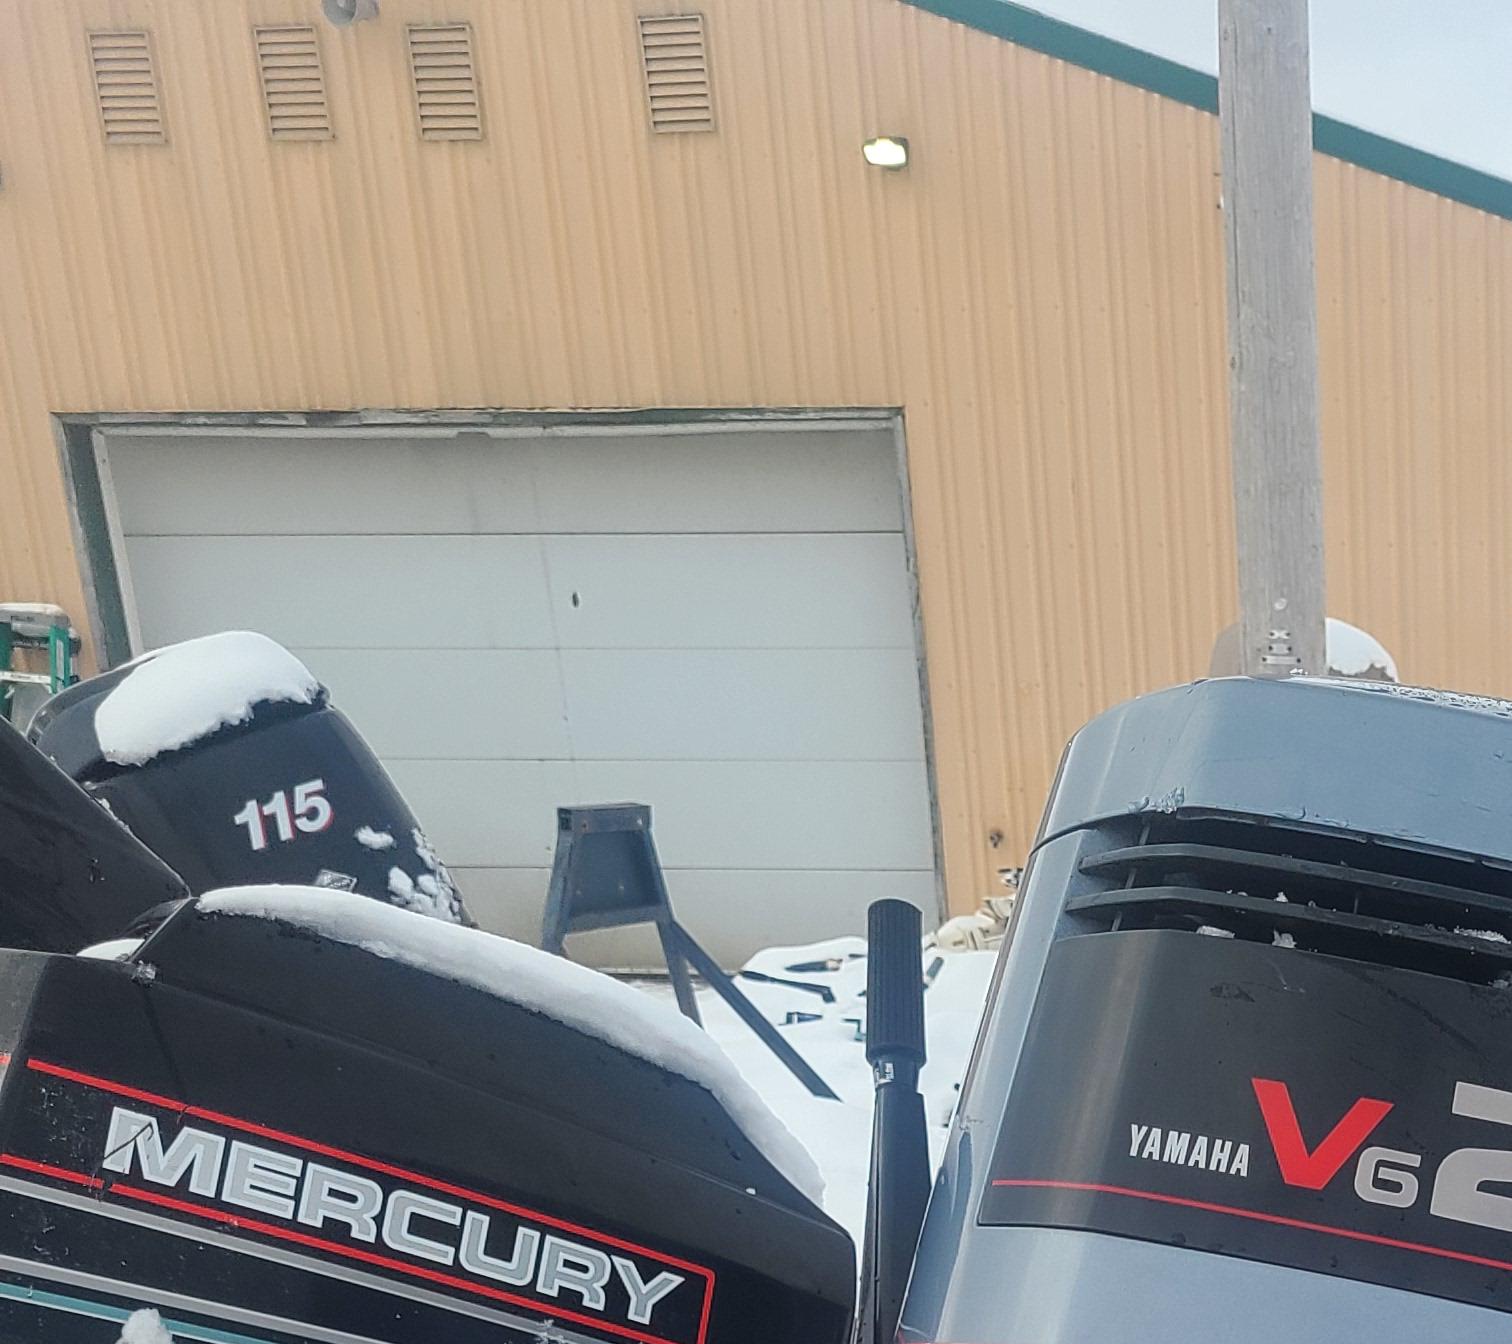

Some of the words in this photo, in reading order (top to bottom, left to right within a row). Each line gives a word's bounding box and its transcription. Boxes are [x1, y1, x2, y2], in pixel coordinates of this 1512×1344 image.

[233, 778, 335, 850] 115
[1128, 1123, 1251, 1177] YAMAHA
[102, 1106, 685, 1326] MERCURY
